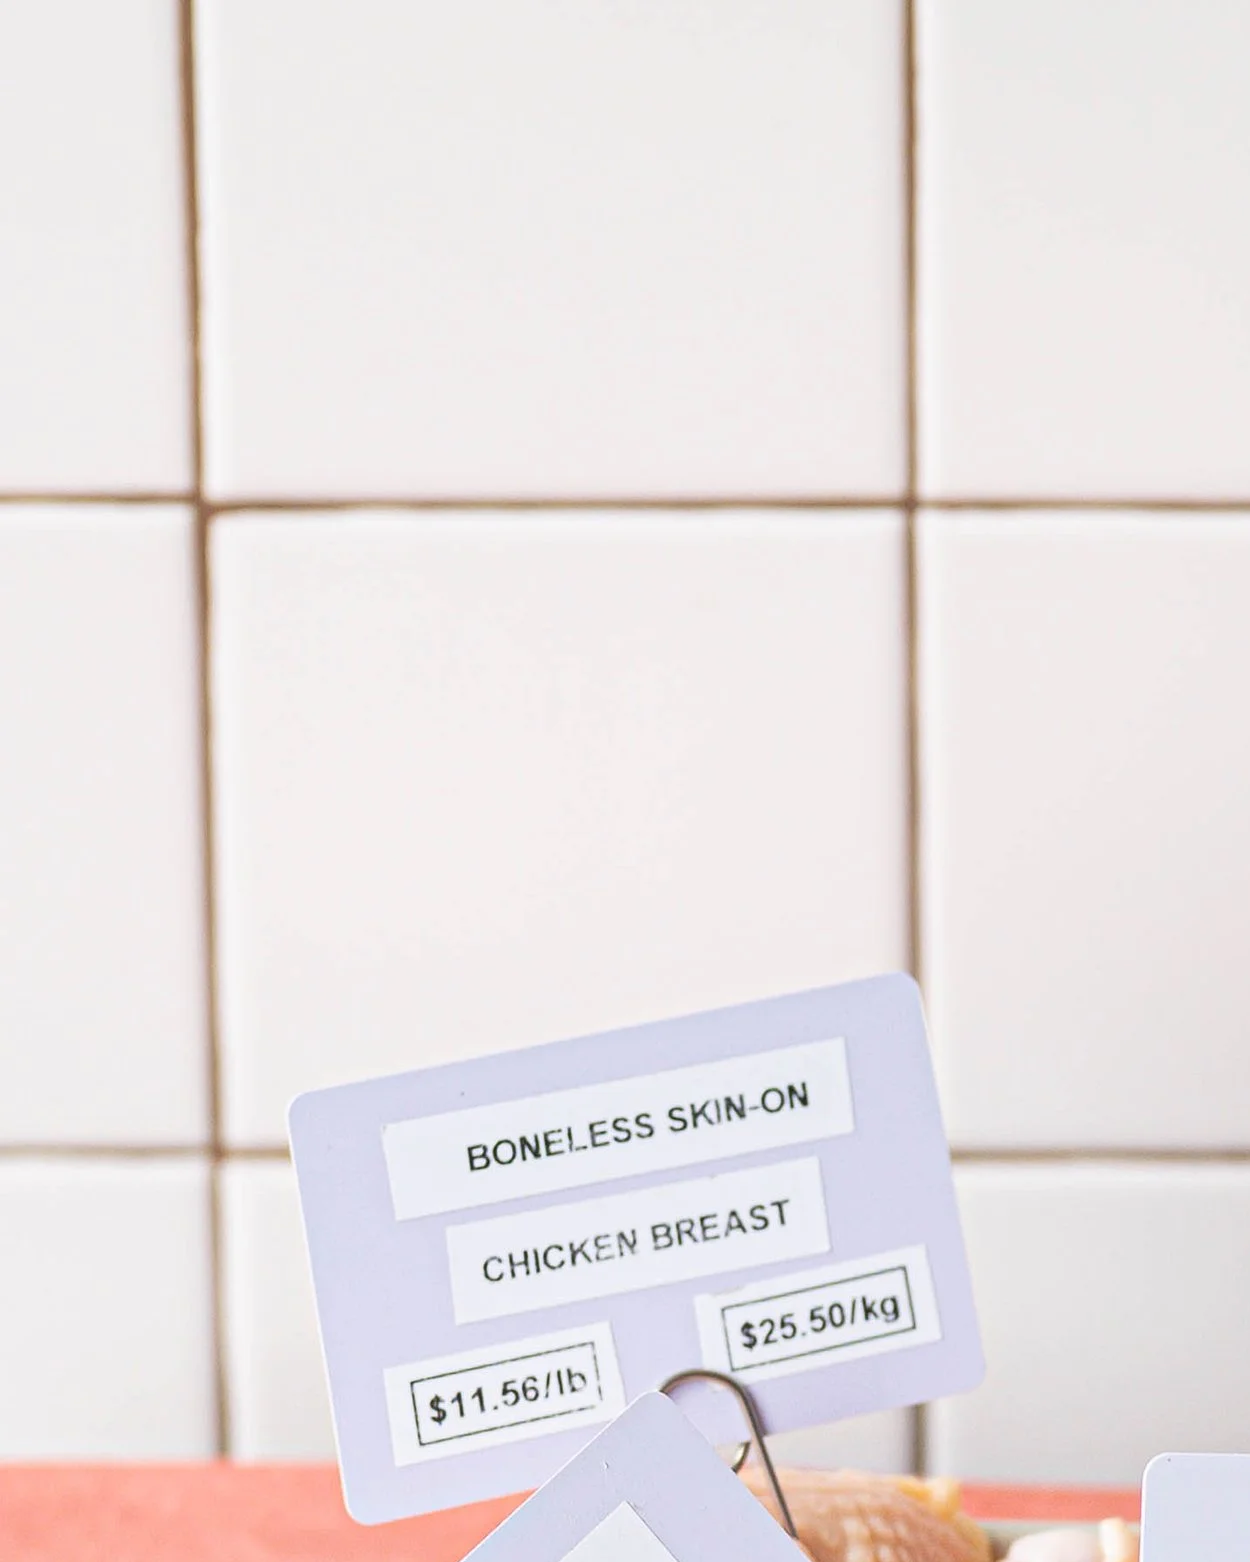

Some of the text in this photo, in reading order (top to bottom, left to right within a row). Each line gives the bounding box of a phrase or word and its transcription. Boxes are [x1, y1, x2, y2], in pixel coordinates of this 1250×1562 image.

[467, 1081, 809, 1172] BONELESS SKIN-ON
[482, 1199, 789, 1282] CHICKEN BREAST
[740, 1295, 900, 1350] $25.50/kg
[429, 1367, 587, 1426] $11.56/lb
